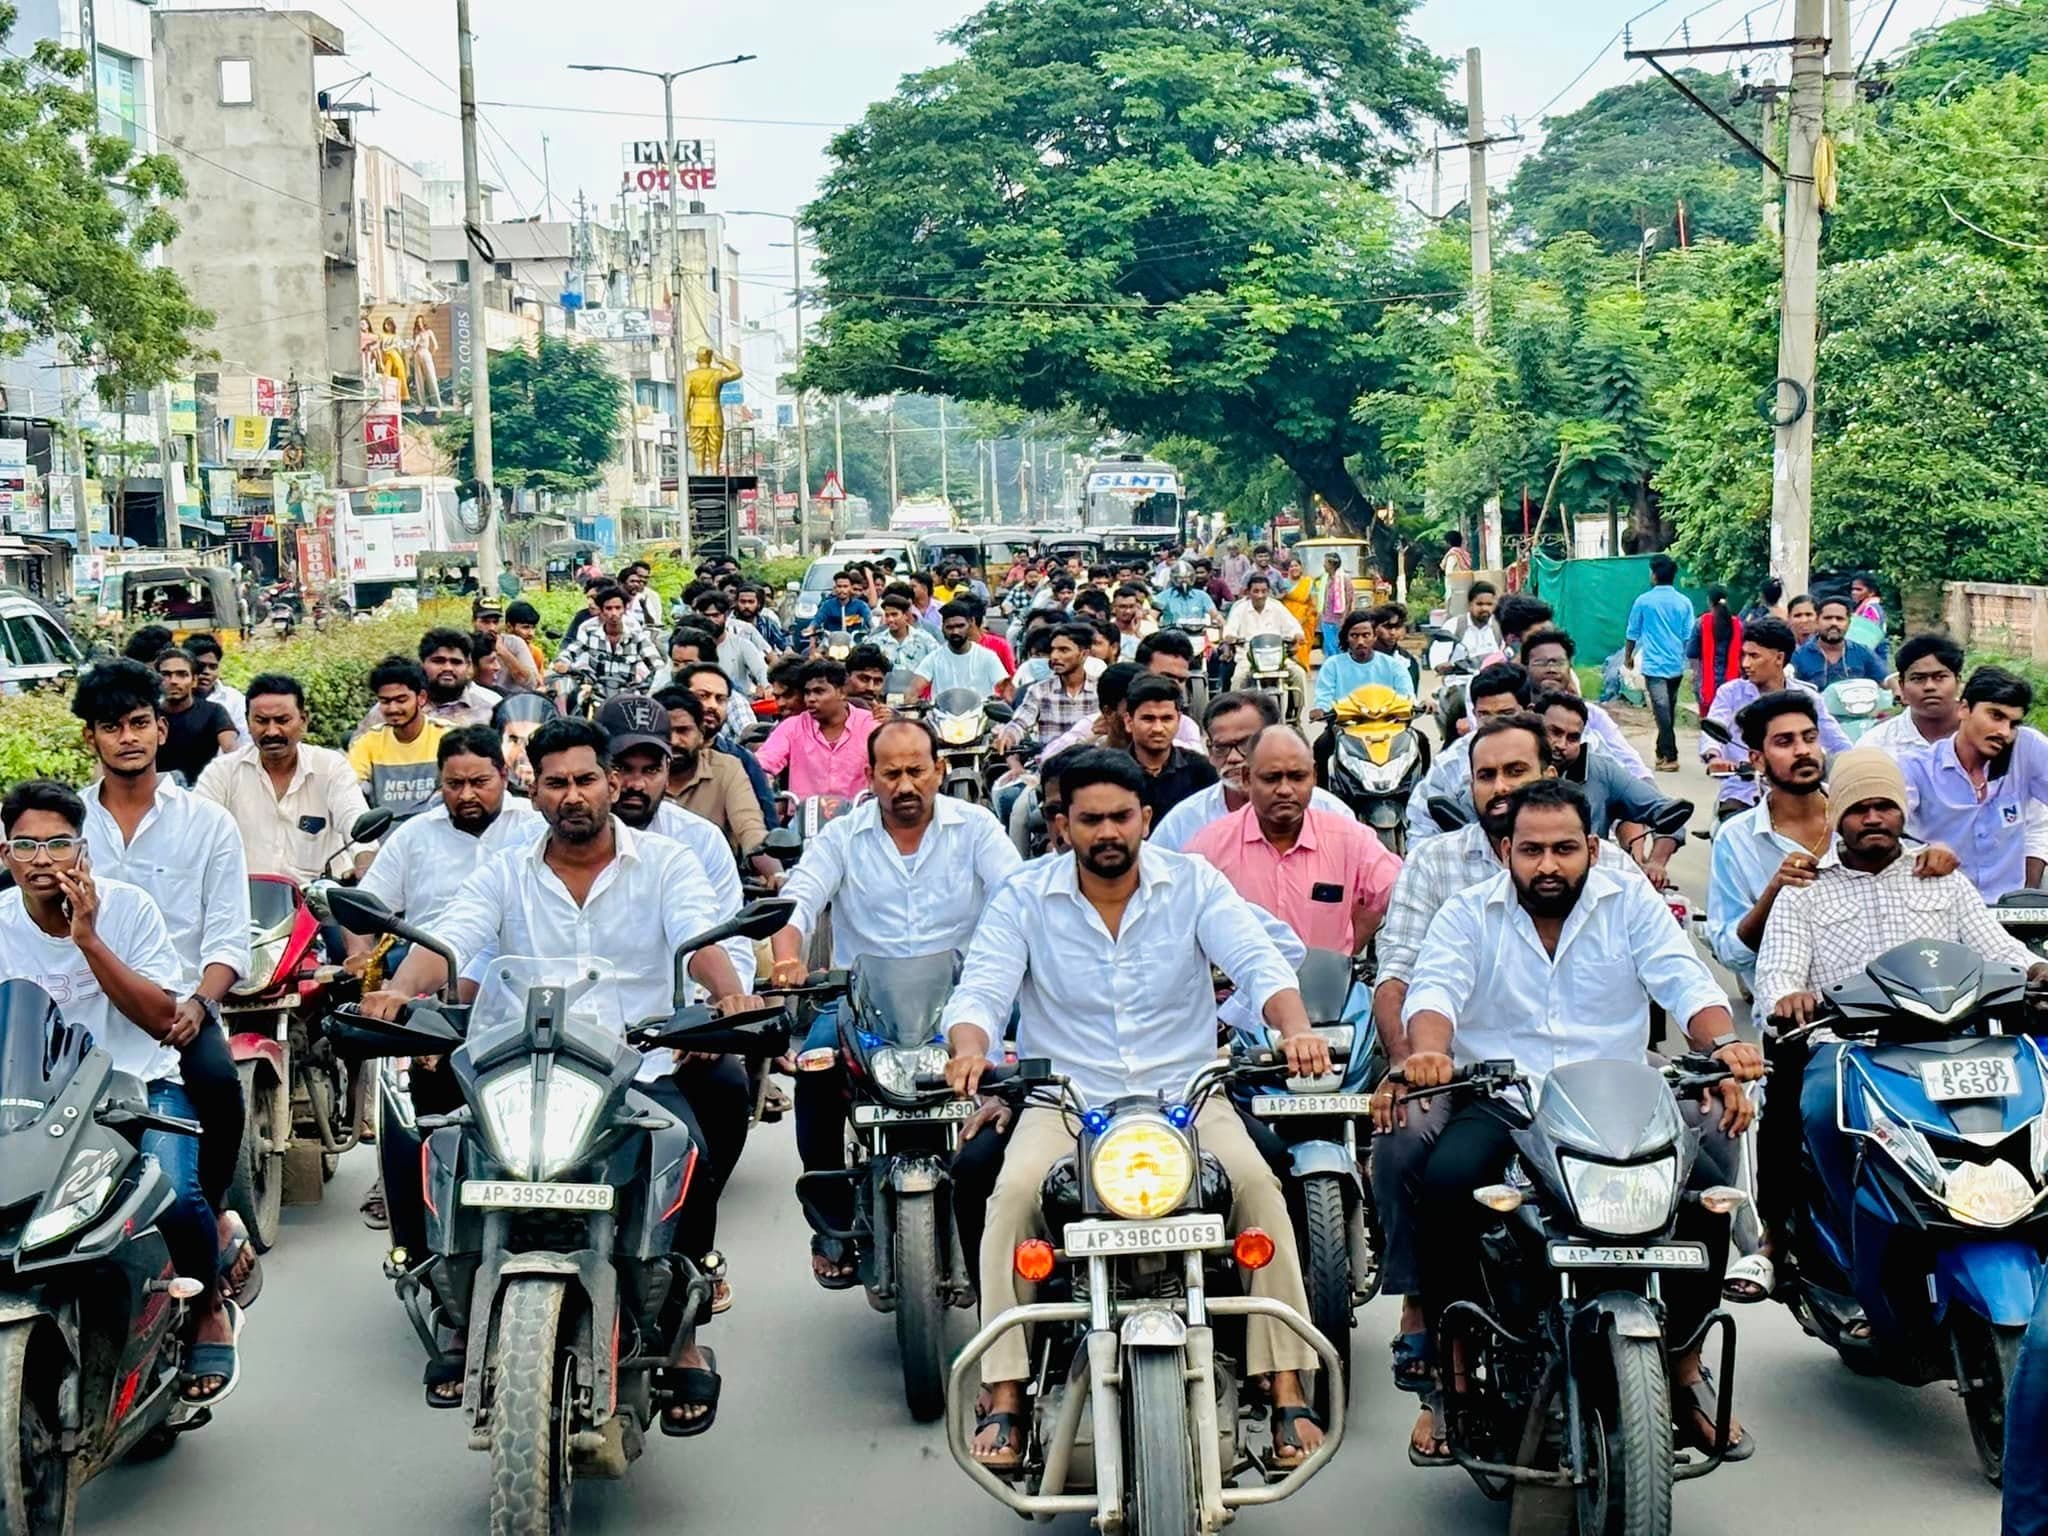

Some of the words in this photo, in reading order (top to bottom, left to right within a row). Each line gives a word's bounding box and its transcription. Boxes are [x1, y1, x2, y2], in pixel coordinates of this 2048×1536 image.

[624, 168, 717, 192] LODGE
[457, 311, 472, 364] COLORS
[1095, 474, 1170, 487] SLNT
[384, 778, 436, 791] NEVER
[384, 791, 412, 801] GIVE
[482, 1186, 504, 1202] AP
[564, 1188, 608, 1206] 0498
[1568, 1249, 1589, 1261] AP
